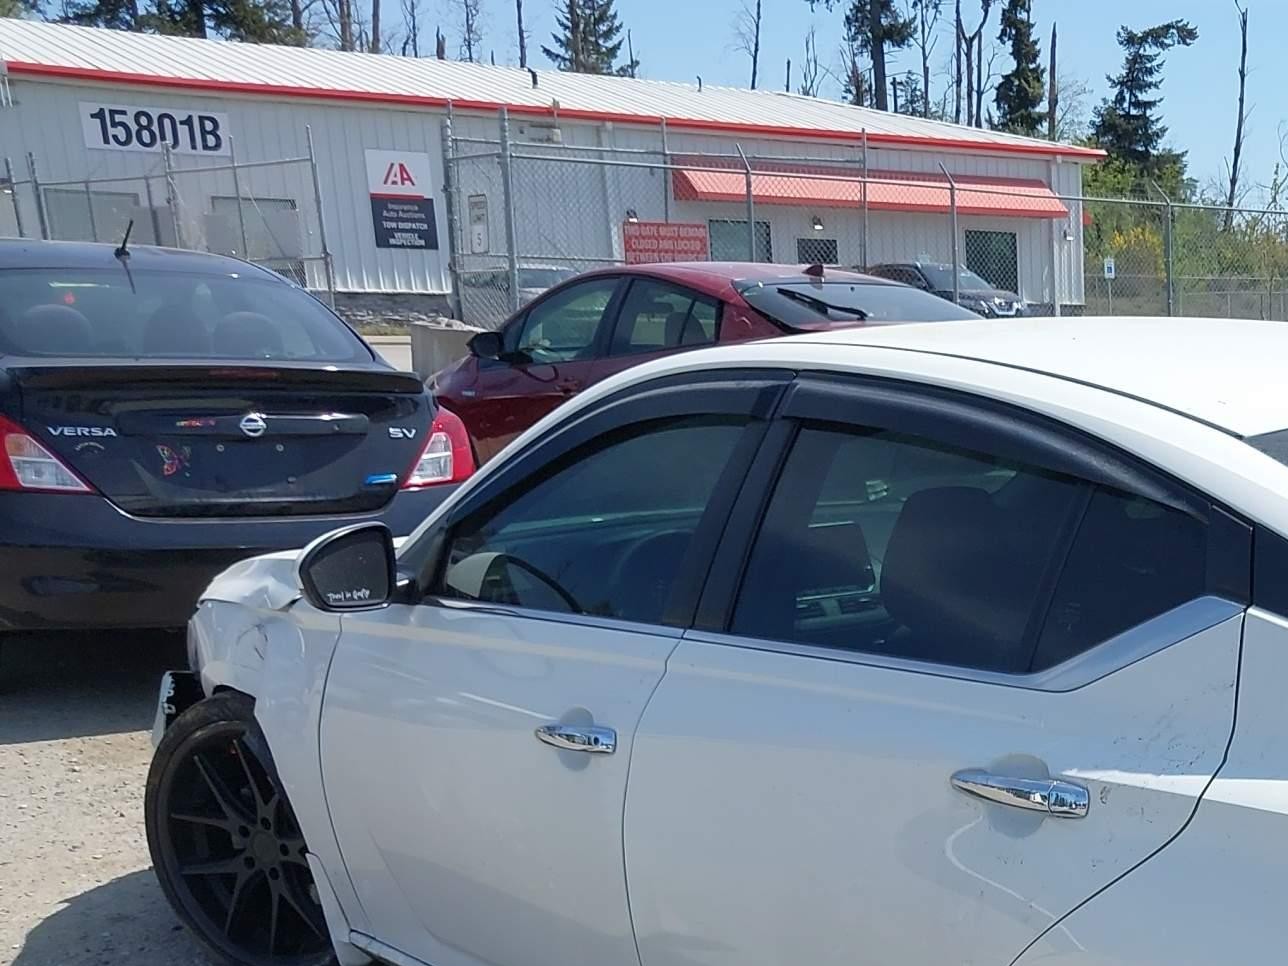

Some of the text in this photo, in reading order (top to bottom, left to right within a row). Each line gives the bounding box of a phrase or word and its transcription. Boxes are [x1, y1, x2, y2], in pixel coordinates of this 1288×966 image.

[89, 107, 222, 152] 15801B
[382, 209, 426, 219] Auto Auctions
[381, 221, 429, 231] TOW DISPATCH
[641, 225, 658, 237] GATE
[393, 231, 419, 240] VEHICLE
[388, 238, 426, 247] INSPECTION
[631, 238, 658, 249] CLOSED
[48, 426, 117, 437] VERSA
[389, 427, 416, 438] SV
